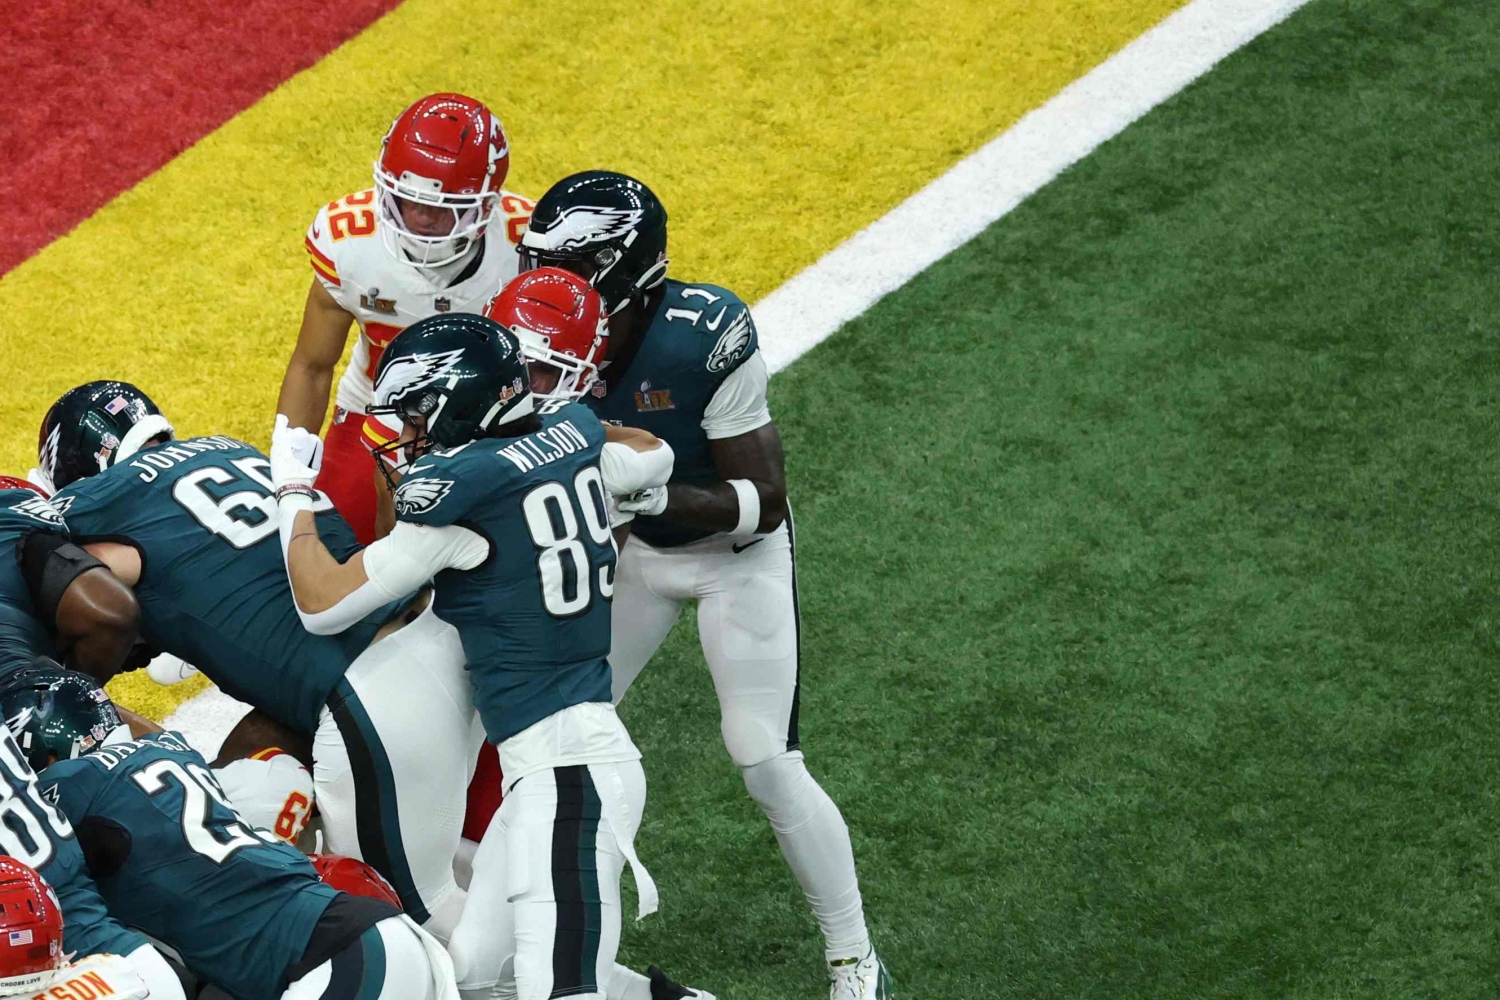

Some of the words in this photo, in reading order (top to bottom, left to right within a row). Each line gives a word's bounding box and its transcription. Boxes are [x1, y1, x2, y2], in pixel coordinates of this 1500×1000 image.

[665, 287, 721, 327] 11
[496, 420, 589, 474] WILSON
[521, 464, 618, 619] 89
